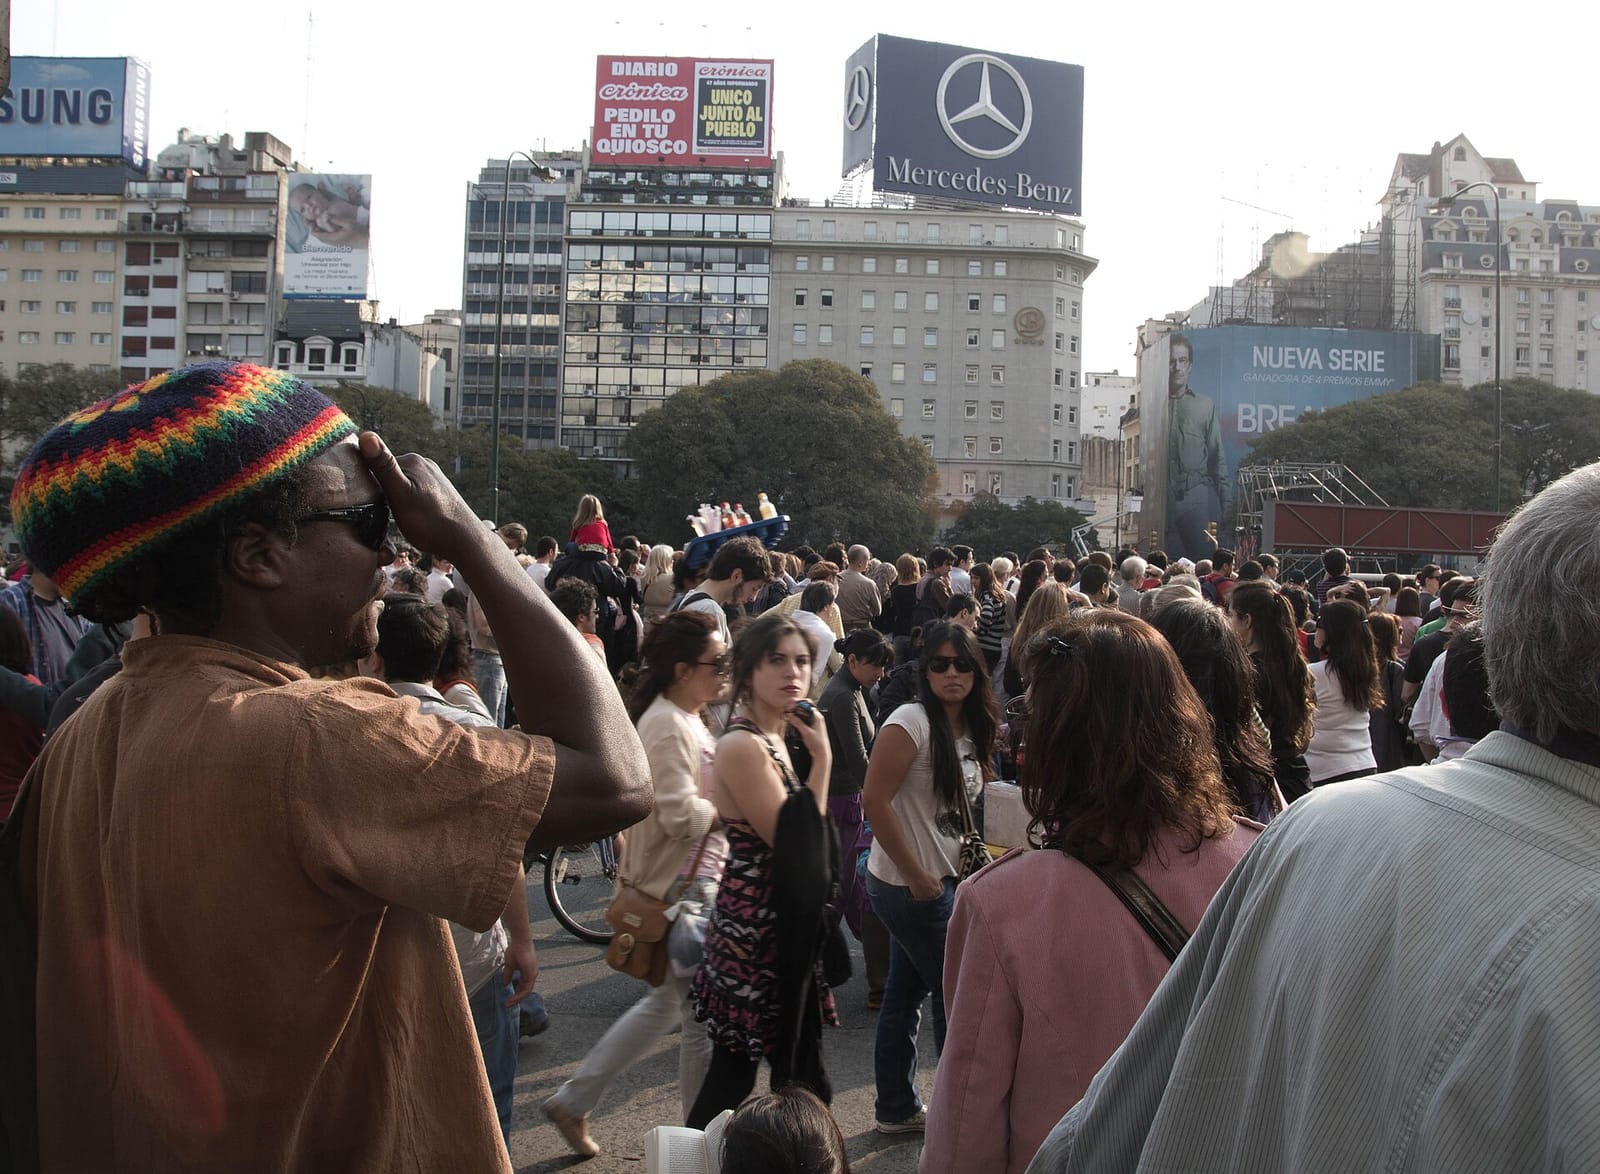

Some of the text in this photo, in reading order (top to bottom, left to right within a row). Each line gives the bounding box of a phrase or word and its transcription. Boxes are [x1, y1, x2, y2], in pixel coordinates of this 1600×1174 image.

[611, 61, 678, 77] DIARIO
[711, 89, 753, 106] UNICO
[132, 62, 147, 168] SAMSUNG
[604, 108, 676, 124] PEDILO
[700, 105, 764, 122] JUNTO AL
[610, 123, 669, 139] EN TU
[705, 121, 756, 138] PUEBLO
[596, 138, 688, 155] QUIOSCO
[887, 155, 1073, 204] Mercedes-Benz
[1253, 345, 1385, 373] NUEVA SERIE
[1242, 372, 1299, 384] GANADORA
[1301, 374, 1314, 384] DE
[1315, 375, 1321, 384] 4
[1323, 375, 1362, 386] PREMIOS
